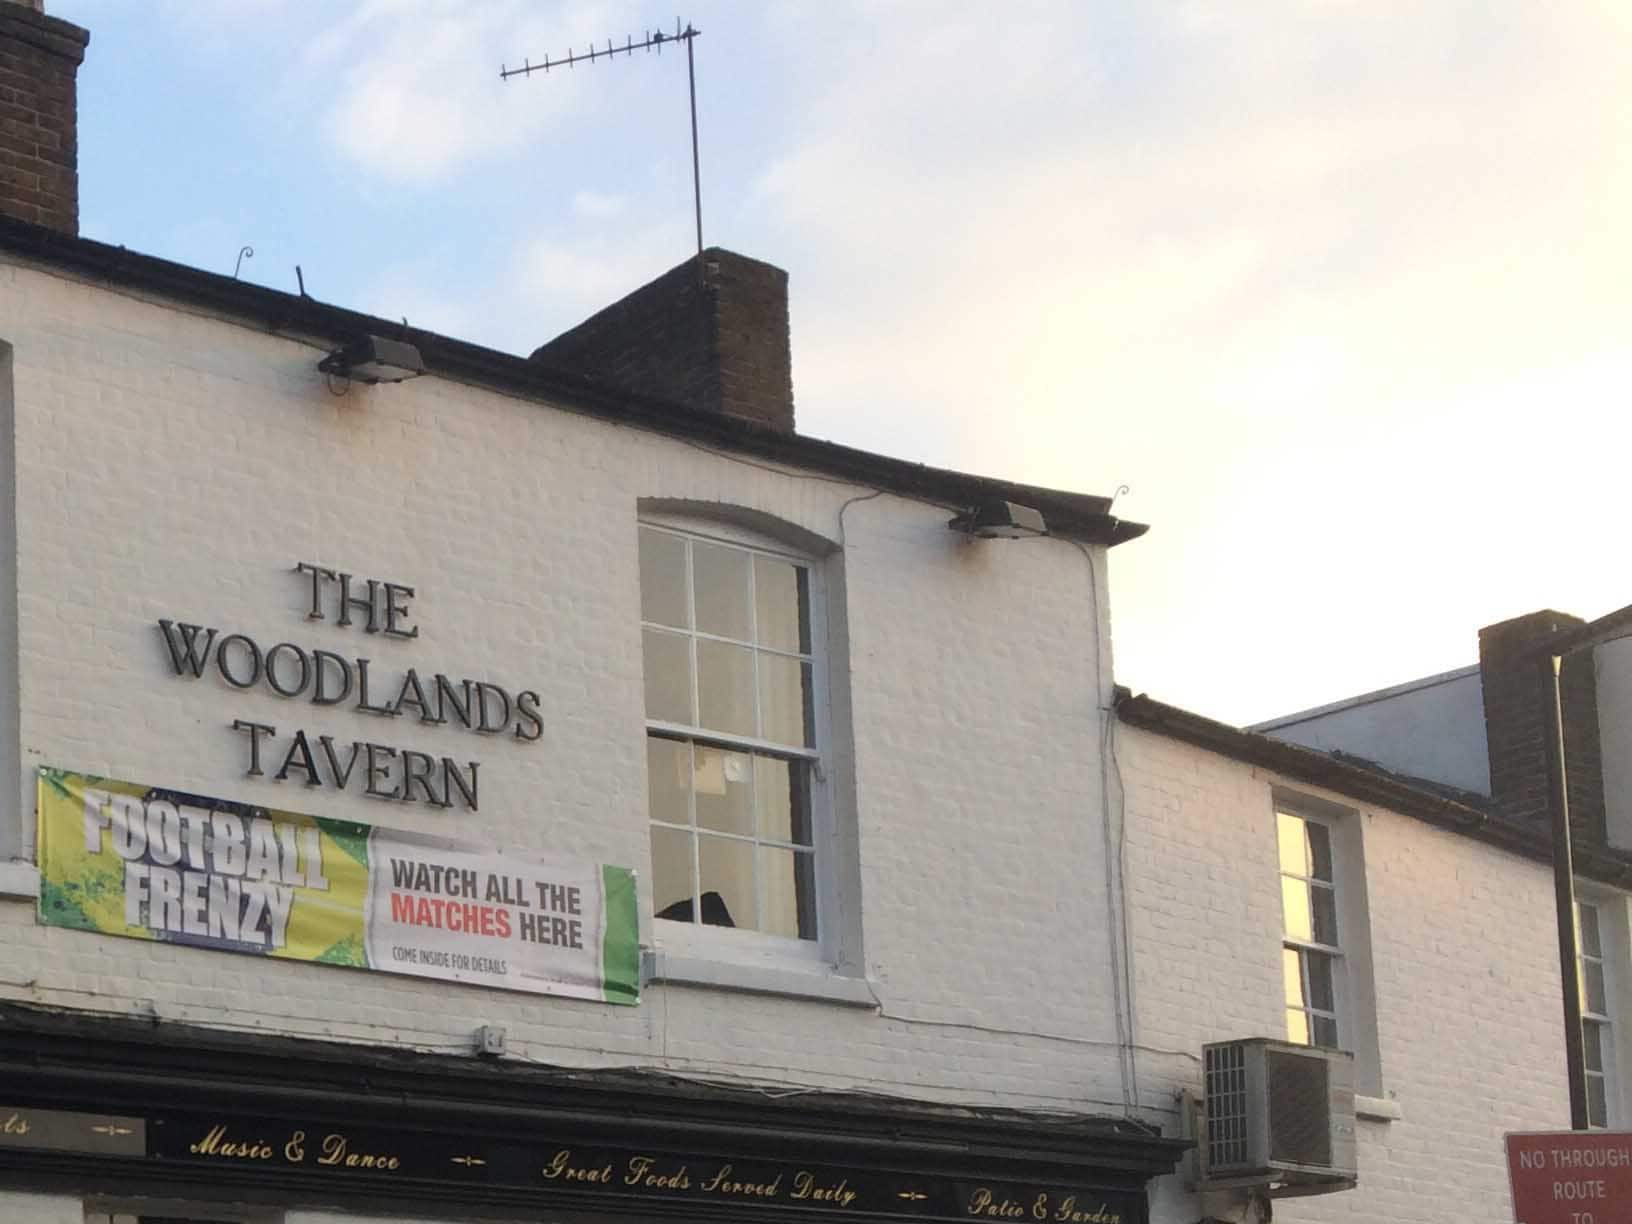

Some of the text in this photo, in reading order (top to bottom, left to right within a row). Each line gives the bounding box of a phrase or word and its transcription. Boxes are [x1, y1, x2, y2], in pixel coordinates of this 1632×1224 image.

[296, 562, 419, 639] THE
[158, 619, 544, 741] WOODLANDS
[233, 719, 480, 811] TAVERN
[82, 789, 329, 891] FOOTBALL
[123, 862, 295, 948] FRENZY
[390, 858, 582, 916] WATCH ALL THE
[391, 892, 583, 950] MATCHES HERE
[391, 946, 508, 976] COME INSIDE FOR DETAILS
[190, 1124, 401, 1170] Music & Dance
[1519, 1148, 1630, 1169] NO THROUGH
[542, 1149, 857, 1207] Great Foods Served Daily
[967, 1187, 1121, 1224] Patio & Garden
[1552, 1180, 1607, 1201] ROUTE
